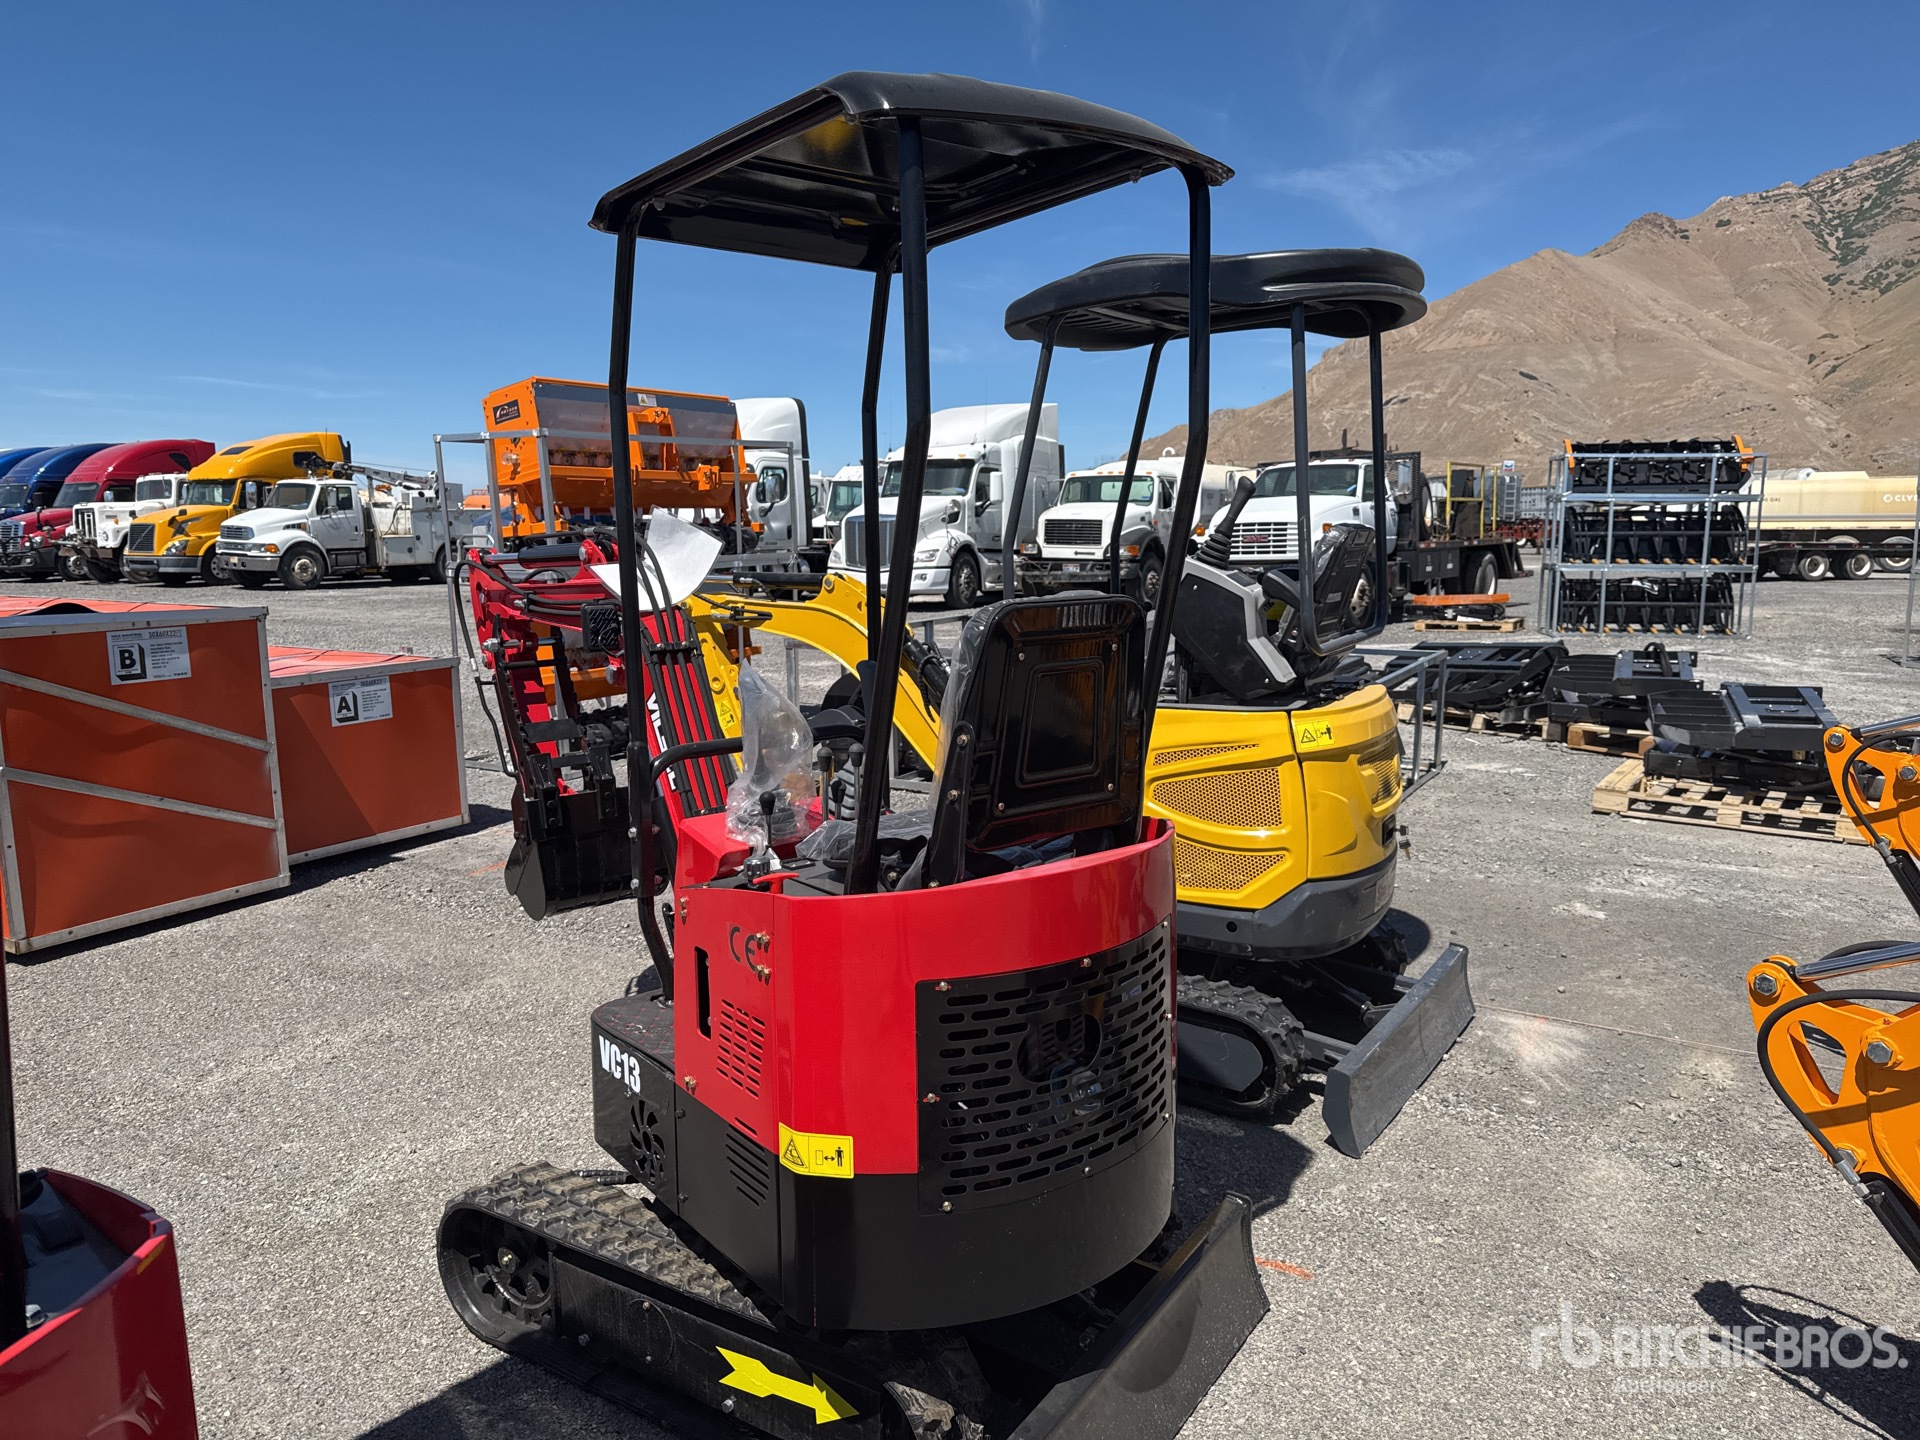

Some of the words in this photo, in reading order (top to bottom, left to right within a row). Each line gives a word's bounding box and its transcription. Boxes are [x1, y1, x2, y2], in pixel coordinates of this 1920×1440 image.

[118, 648, 137, 670] B
[337, 695, 352, 714] A
[598, 1034, 641, 1094] VC13
